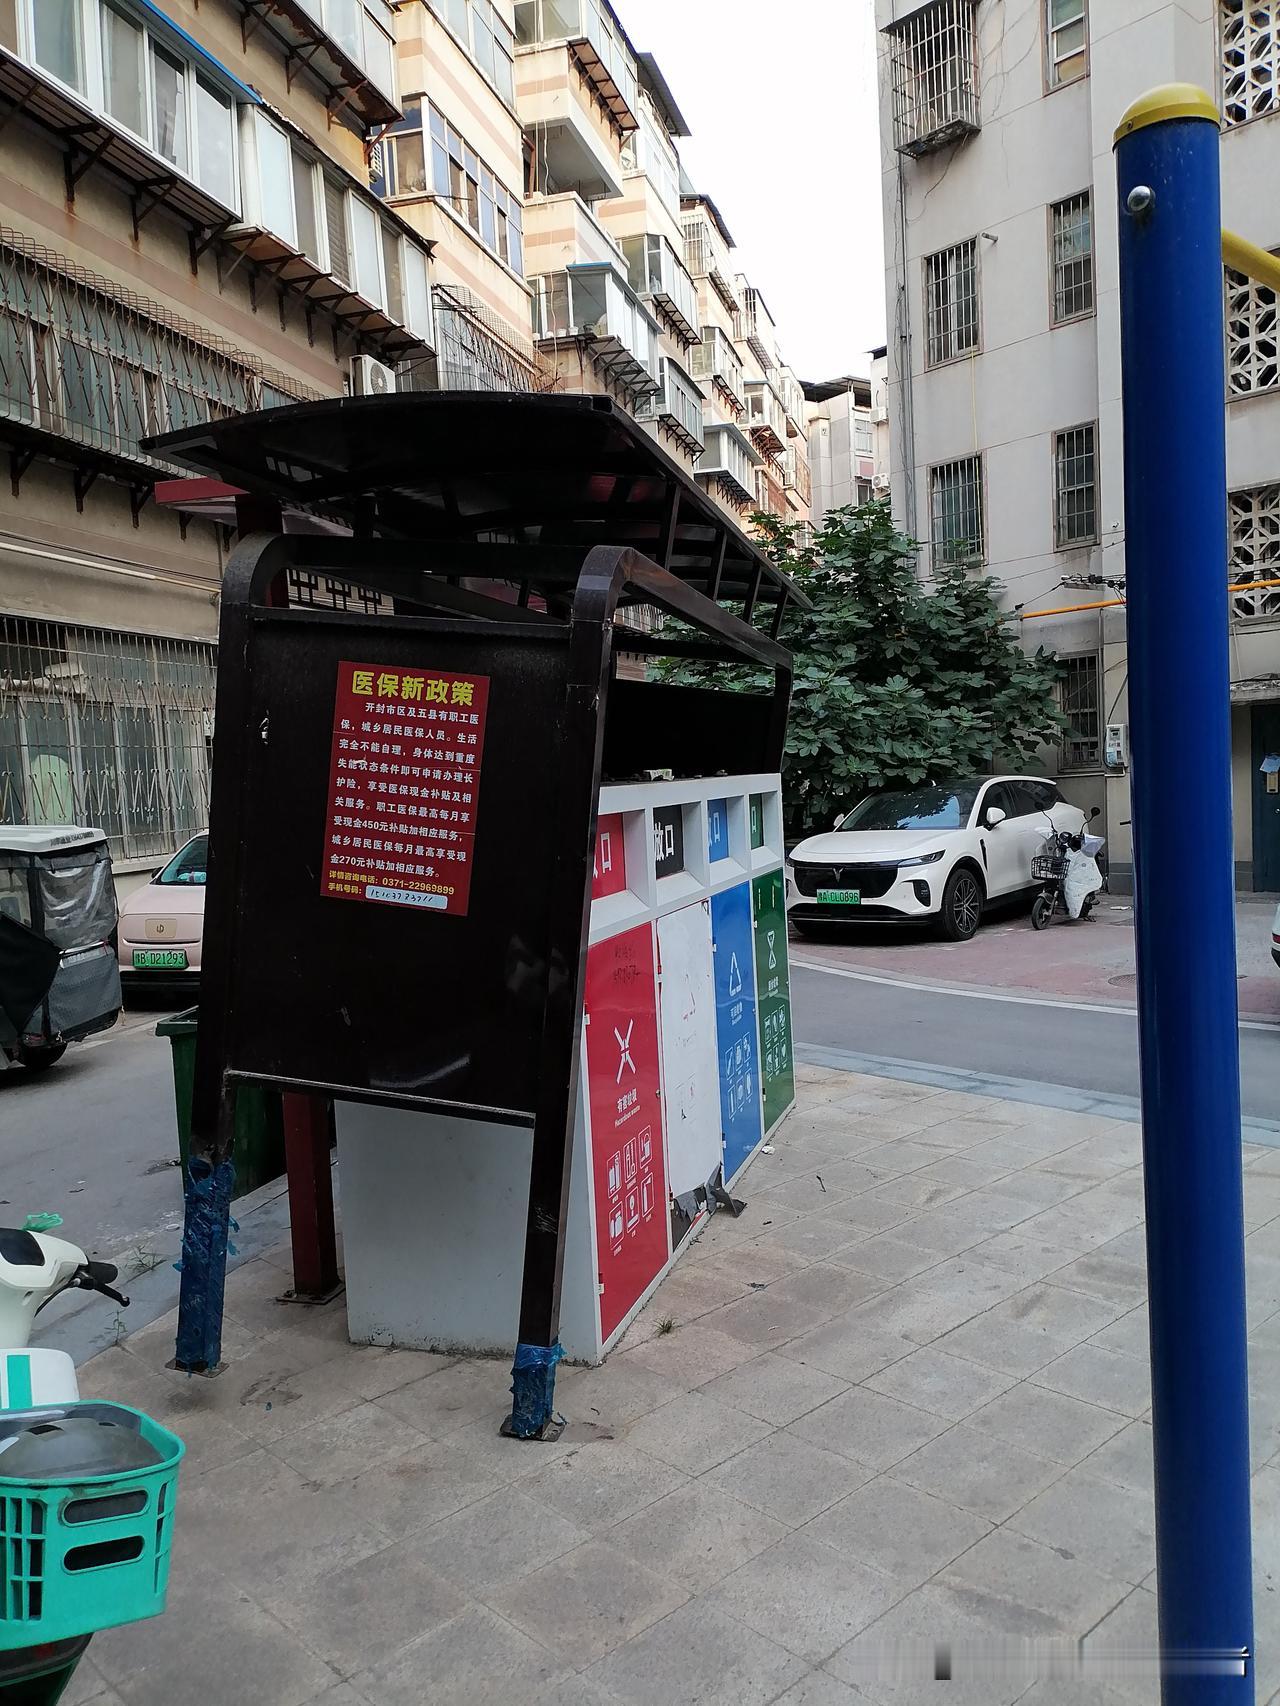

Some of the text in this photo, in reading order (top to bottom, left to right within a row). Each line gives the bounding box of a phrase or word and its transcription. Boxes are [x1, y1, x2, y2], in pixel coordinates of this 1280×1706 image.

[352, 670, 475, 707] 医保新政策
[365, 702, 480, 725] 开封市区及五县有职工医
[340, 718, 478, 745] 保，城乡居民医保人员。生活
[338, 738, 476, 765] 完全不能自理，身体达到重度
[337, 757, 474, 784] 失能状态条件即可申请办理长
[336, 776, 472, 804] 护险，享受医保现金补贴及相
[334, 796, 470, 823] 关服务。职工医保最高每月享
[331, 834, 467, 862] 城乡居民医保每月最高享受现
[330, 853, 440, 878] 金270元补贴加相应服务。
